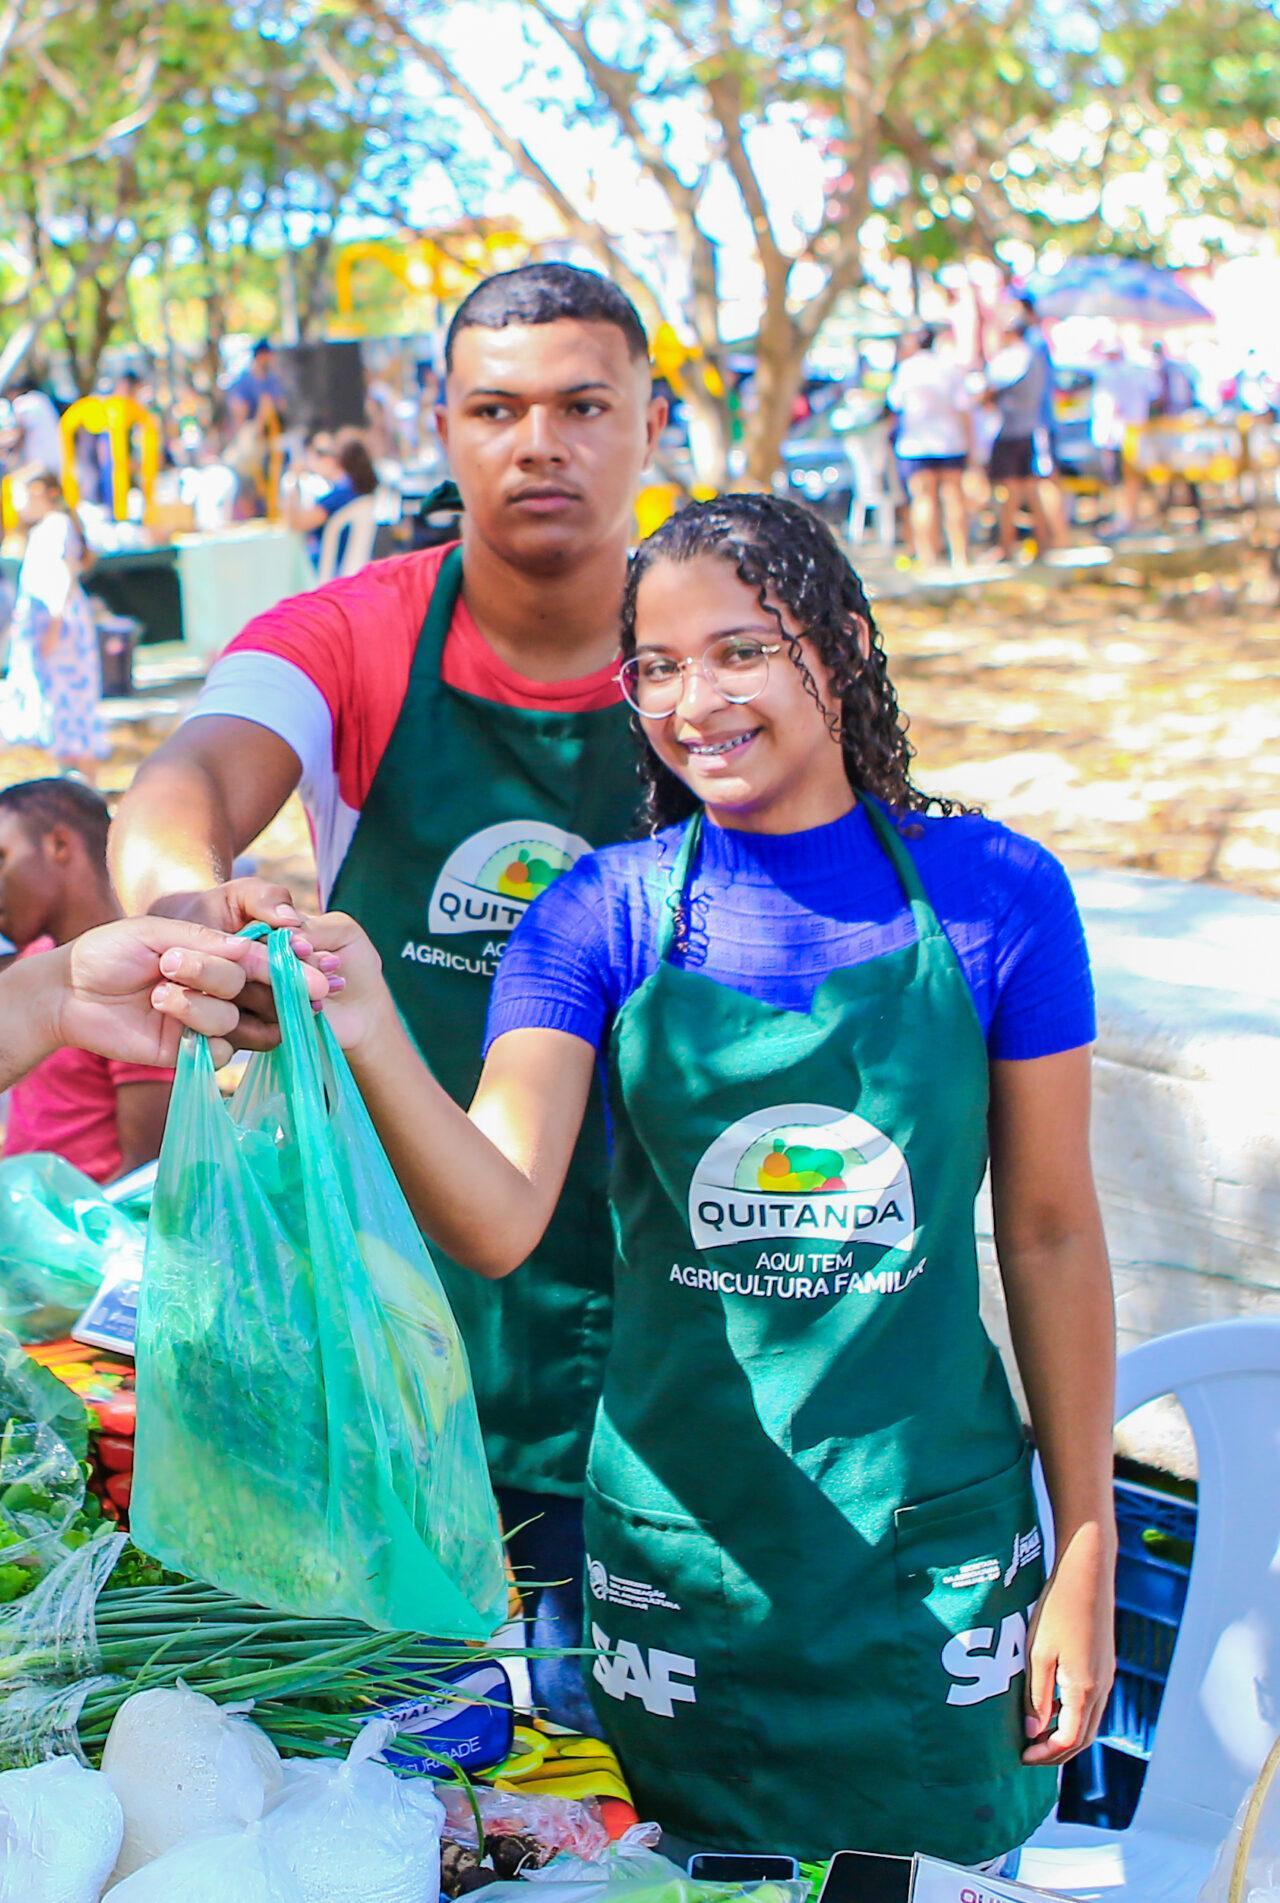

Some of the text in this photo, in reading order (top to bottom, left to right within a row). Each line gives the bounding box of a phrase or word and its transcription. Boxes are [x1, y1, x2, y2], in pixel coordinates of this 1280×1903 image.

[439, 892, 524, 925] QUIT
[401, 941, 501, 977] AGRICULT
[697, 1200, 905, 1233] QUITANDA
[755, 1251, 854, 1274] AQUI TEM
[669, 1263, 830, 1300] AGRICULTURA
[591, 1621, 697, 1718] SAF
[941, 1600, 1037, 1707] SA
